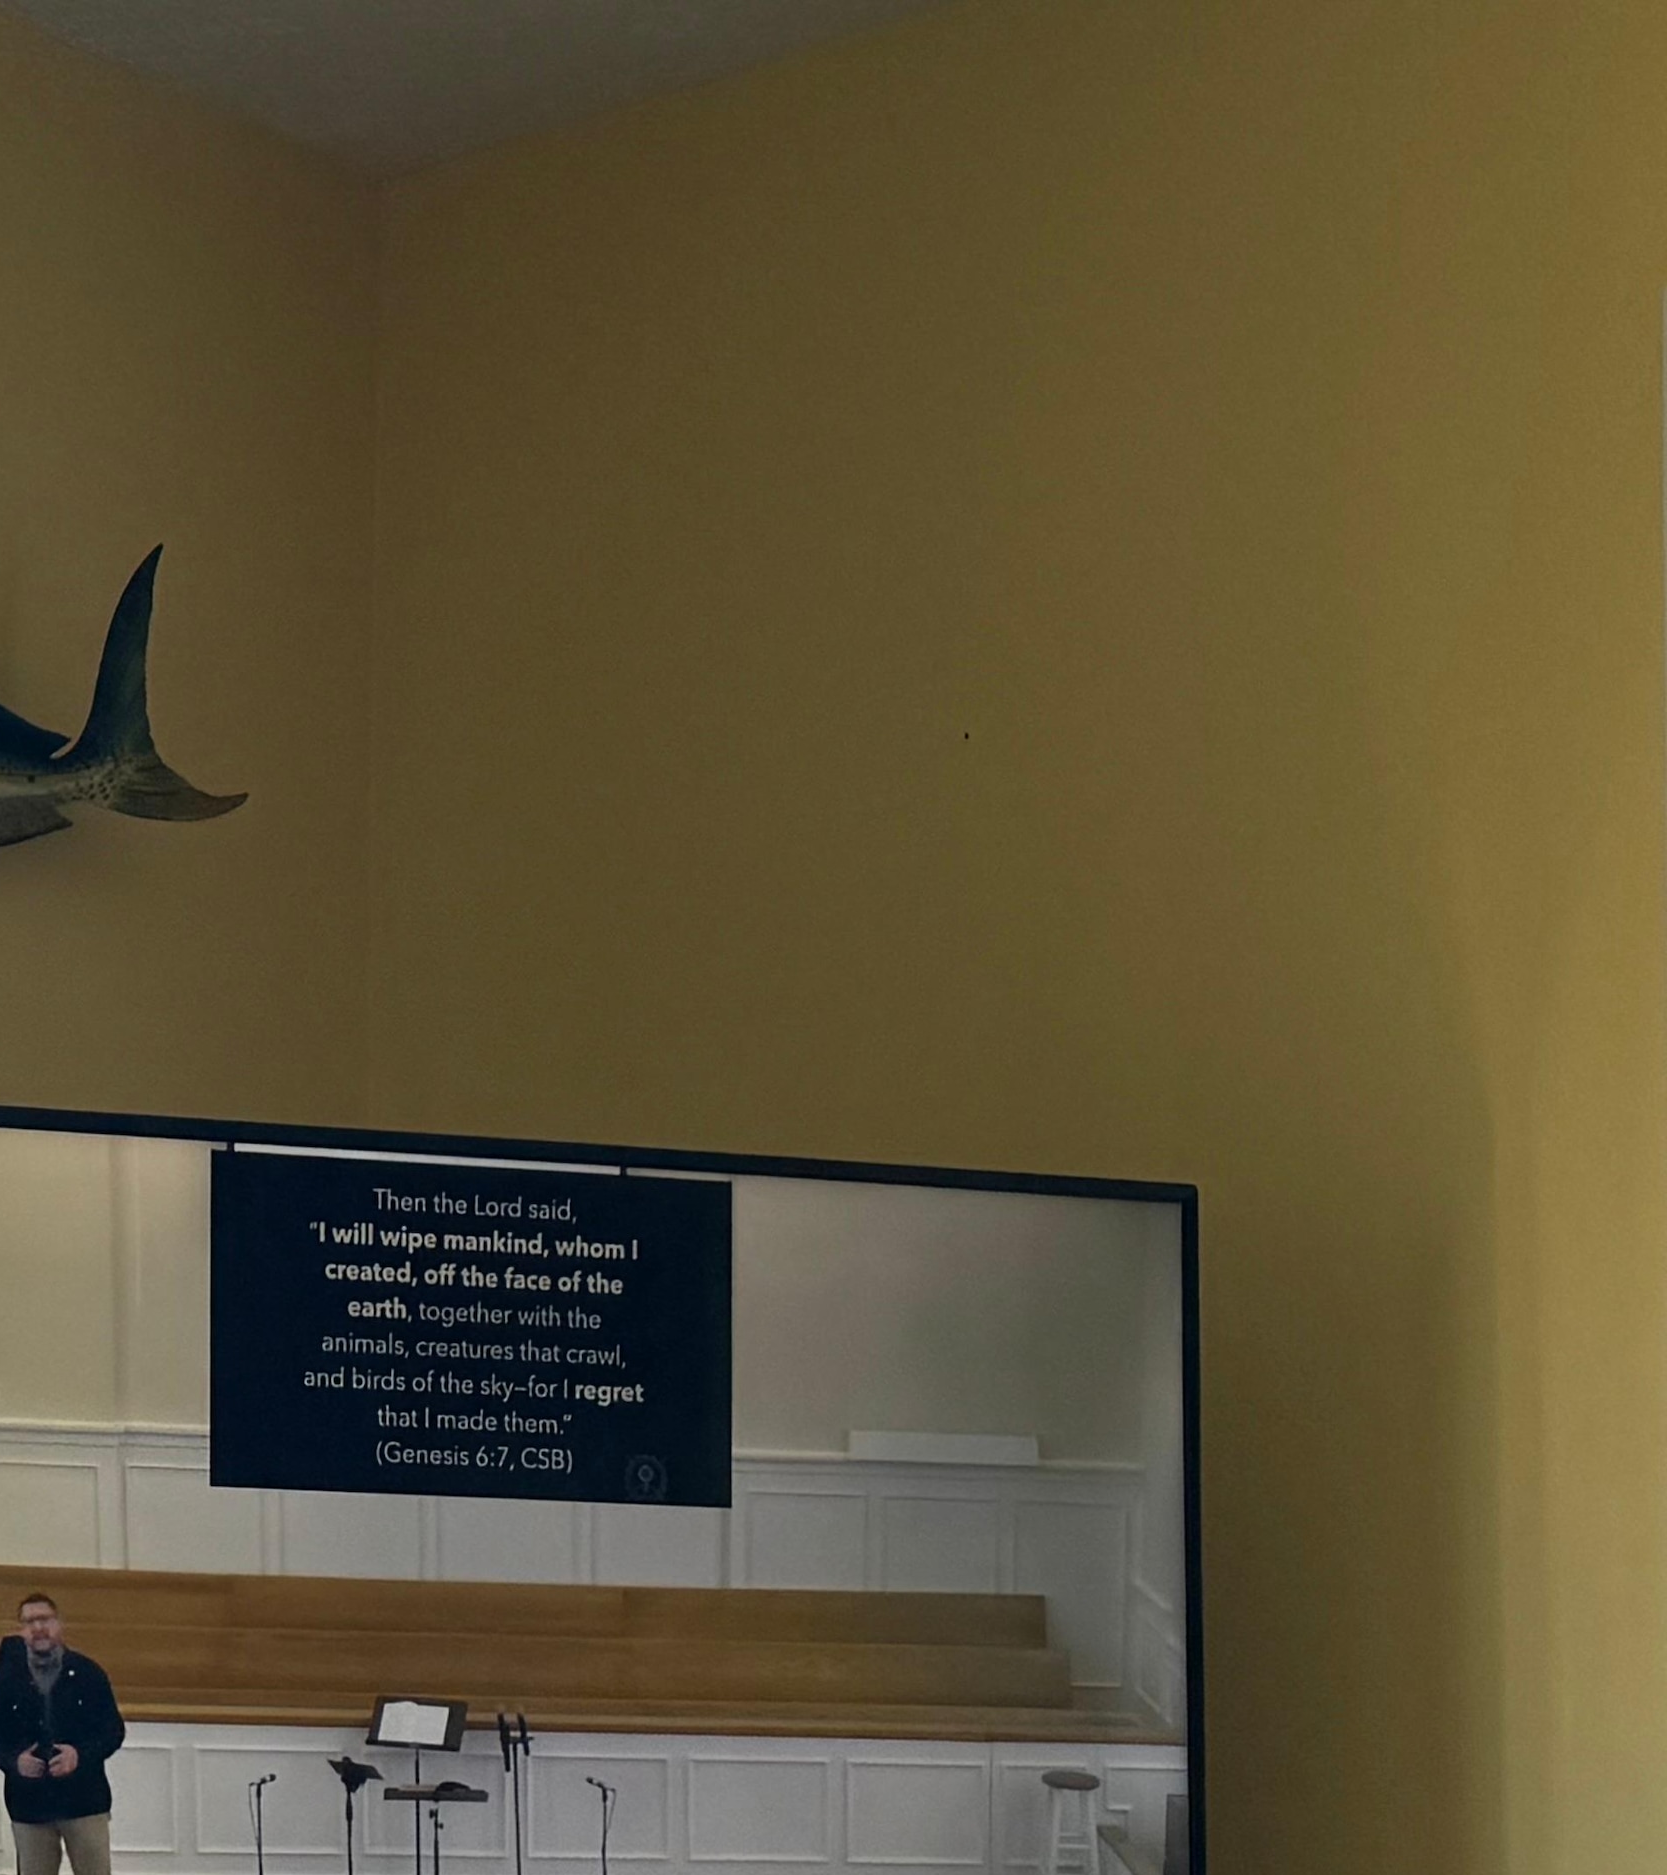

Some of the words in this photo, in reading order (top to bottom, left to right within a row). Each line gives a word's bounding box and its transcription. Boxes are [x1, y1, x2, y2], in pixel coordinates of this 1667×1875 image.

[372, 1187, 427, 1212] Then
[433, 1191, 468, 1215] the
[474, 1194, 522, 1218] Lord
[528, 1198, 577, 1224] said,
[331, 1222, 374, 1246] will
[379, 1225, 438, 1255] wipe
[443, 1229, 549, 1258] mankind,
[554, 1234, 625, 1260] whom
[632, 1239, 638, 1260] I
[324, 1260, 418, 1287] created,
[423, 1262, 457, 1286] off
[460, 1264, 499, 1289] the
[503, 1266, 552, 1291] face
[557, 1270, 582, 1293] of
[586, 1271, 624, 1295] the
[347, 1296, 412, 1323] earth,
[418, 1301, 513, 1328] together
[517, 1305, 561, 1327] with
[567, 1306, 602, 1330] the
[321, 1332, 410, 1359] animals,
[415, 1340, 514, 1361] creatures
[519, 1339, 560, 1363] that
[566, 1344, 626, 1369] crawl,
[303, 1366, 345, 1388] and
[352, 1366, 406, 1391] birds
[412, 1369, 435, 1393] of
[439, 1371, 474, 1395] the
[563, 1378, 568, 1399] I
[574, 1383, 644, 1407] regret
[377, 1404, 418, 1428] that
[424, 1406, 430, 1429] I
[436, 1408, 498, 1432] made
[376, 1440, 470, 1466] (Genesis
[475, 1445, 515, 1471] 6:7,
[520, 1447, 573, 1474] CSB)
